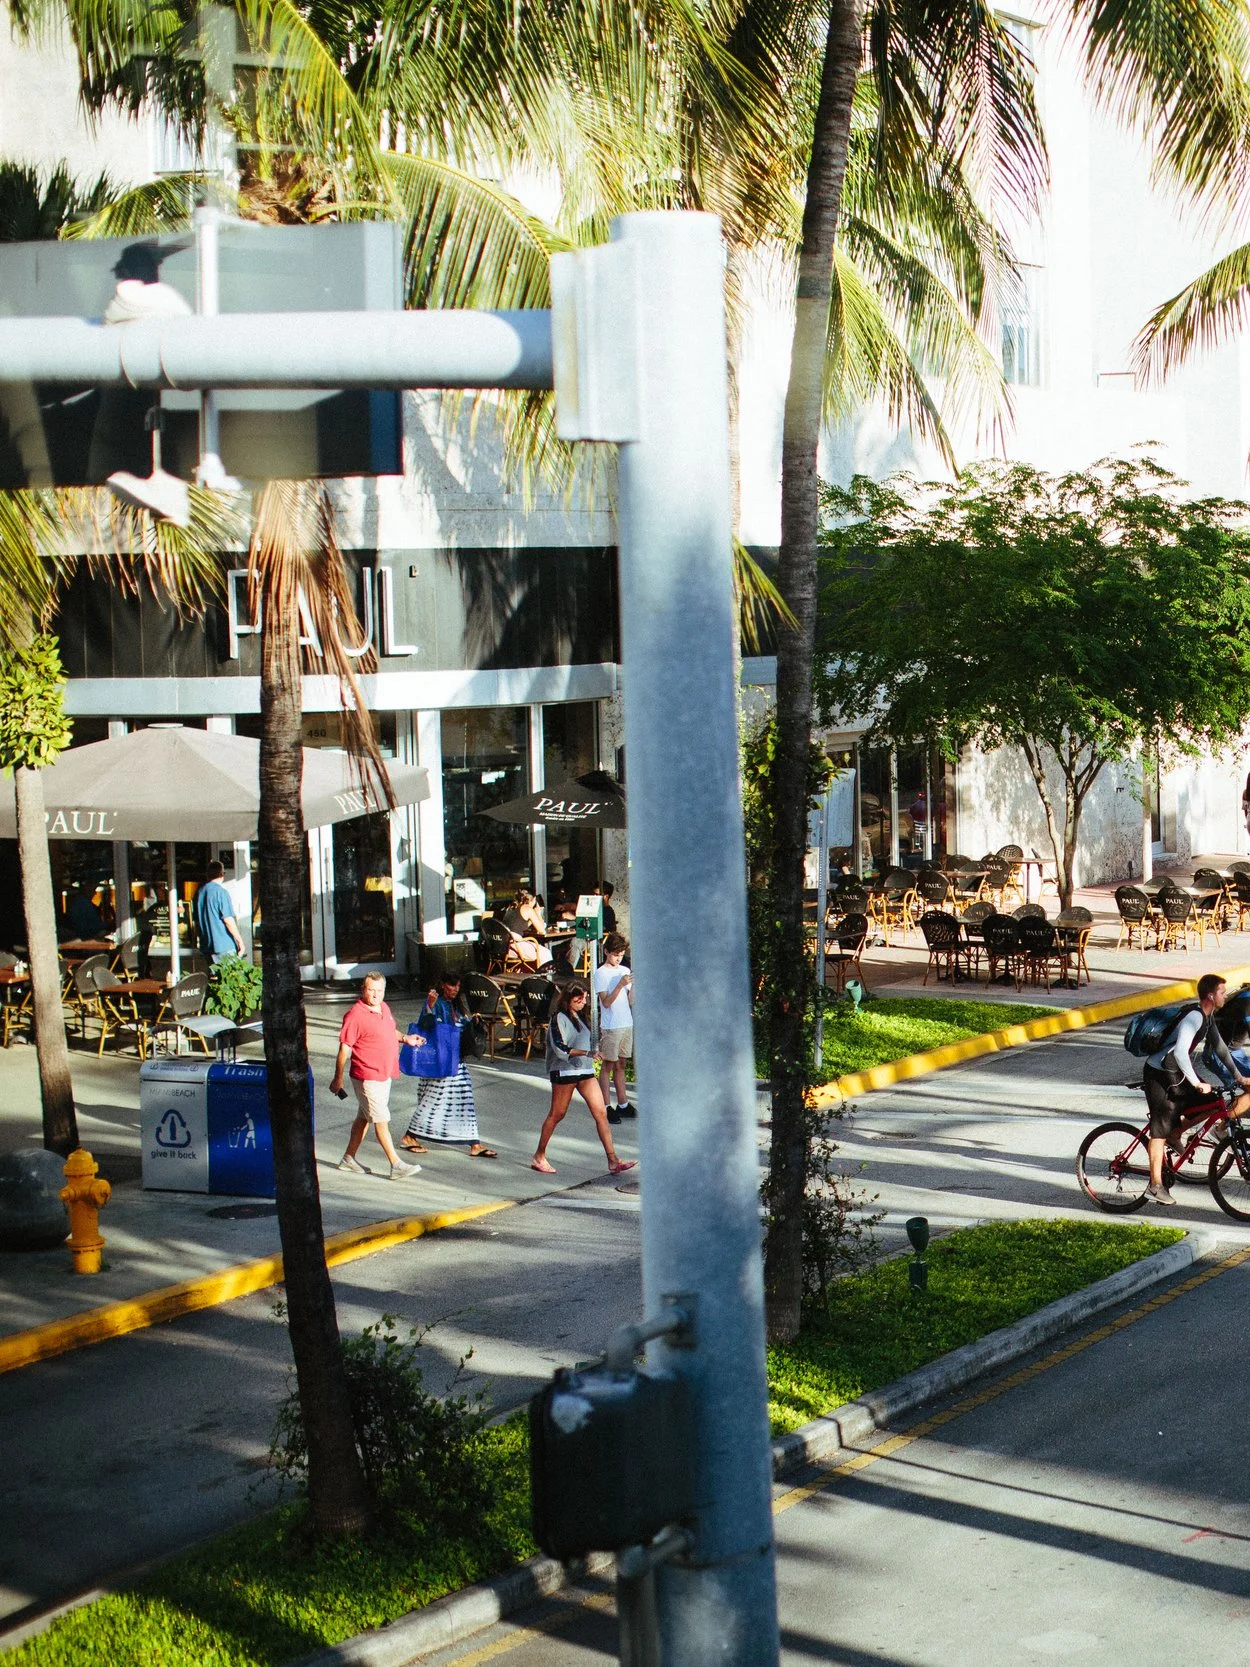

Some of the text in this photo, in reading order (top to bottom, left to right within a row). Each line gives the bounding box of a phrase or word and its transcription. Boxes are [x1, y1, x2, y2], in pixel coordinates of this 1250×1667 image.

[533, 797, 601, 815] PAUL
[1165, 897, 1184, 905] PAUL
[224, 1066, 263, 1077] Trash
[151, 1150, 197, 1160] give it back
